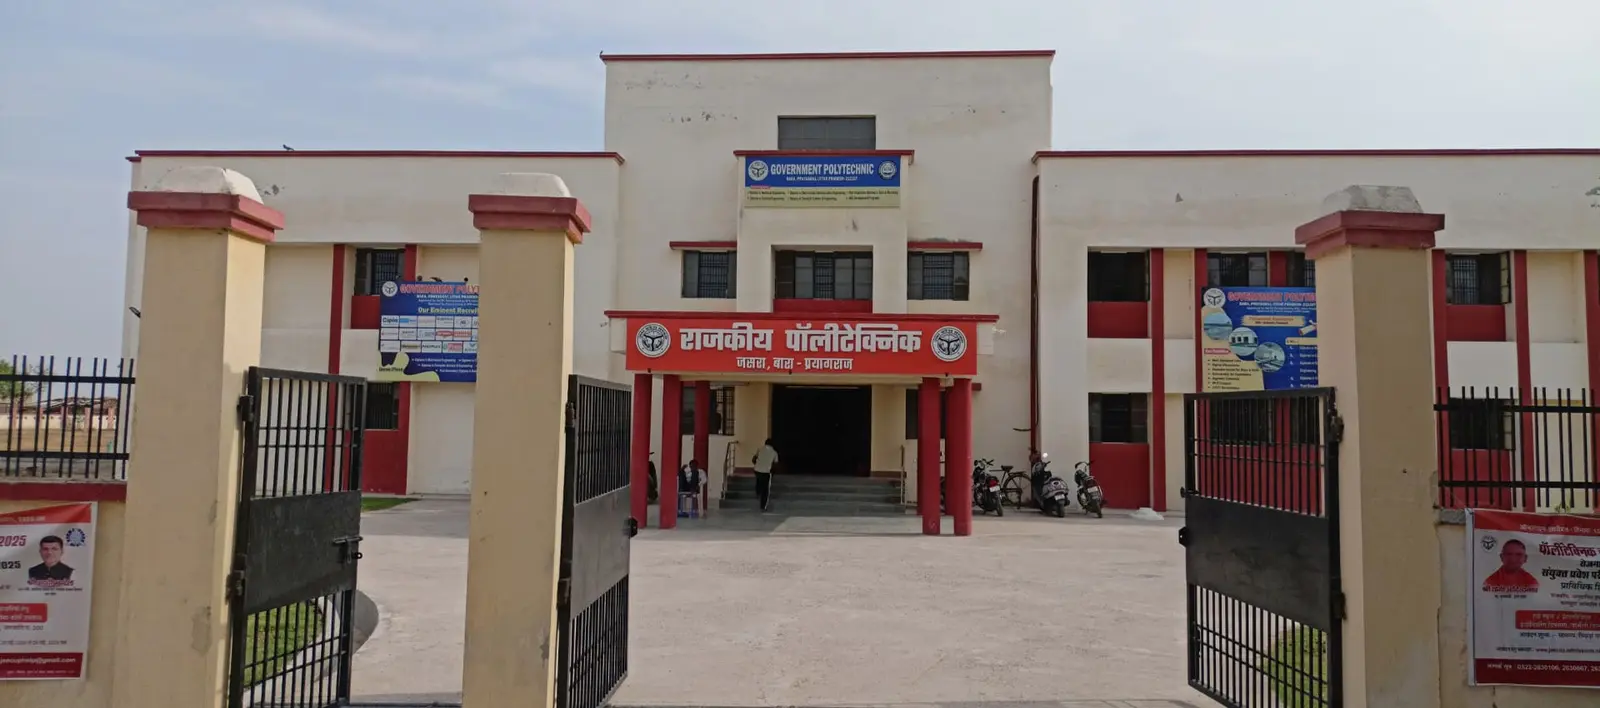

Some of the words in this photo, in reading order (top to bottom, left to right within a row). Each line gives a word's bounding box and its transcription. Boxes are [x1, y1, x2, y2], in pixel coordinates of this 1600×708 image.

[770, 163, 822, 175] GOVERNMENT
[823, 163, 874, 175] POLYTECHNIC
[680, 322, 773, 352] राजकीय
[785, 323, 922, 353] पॉलीटेक्निक
[804, 357, 854, 371] प्रयागराज
[0, 560, 21, 570] 025
